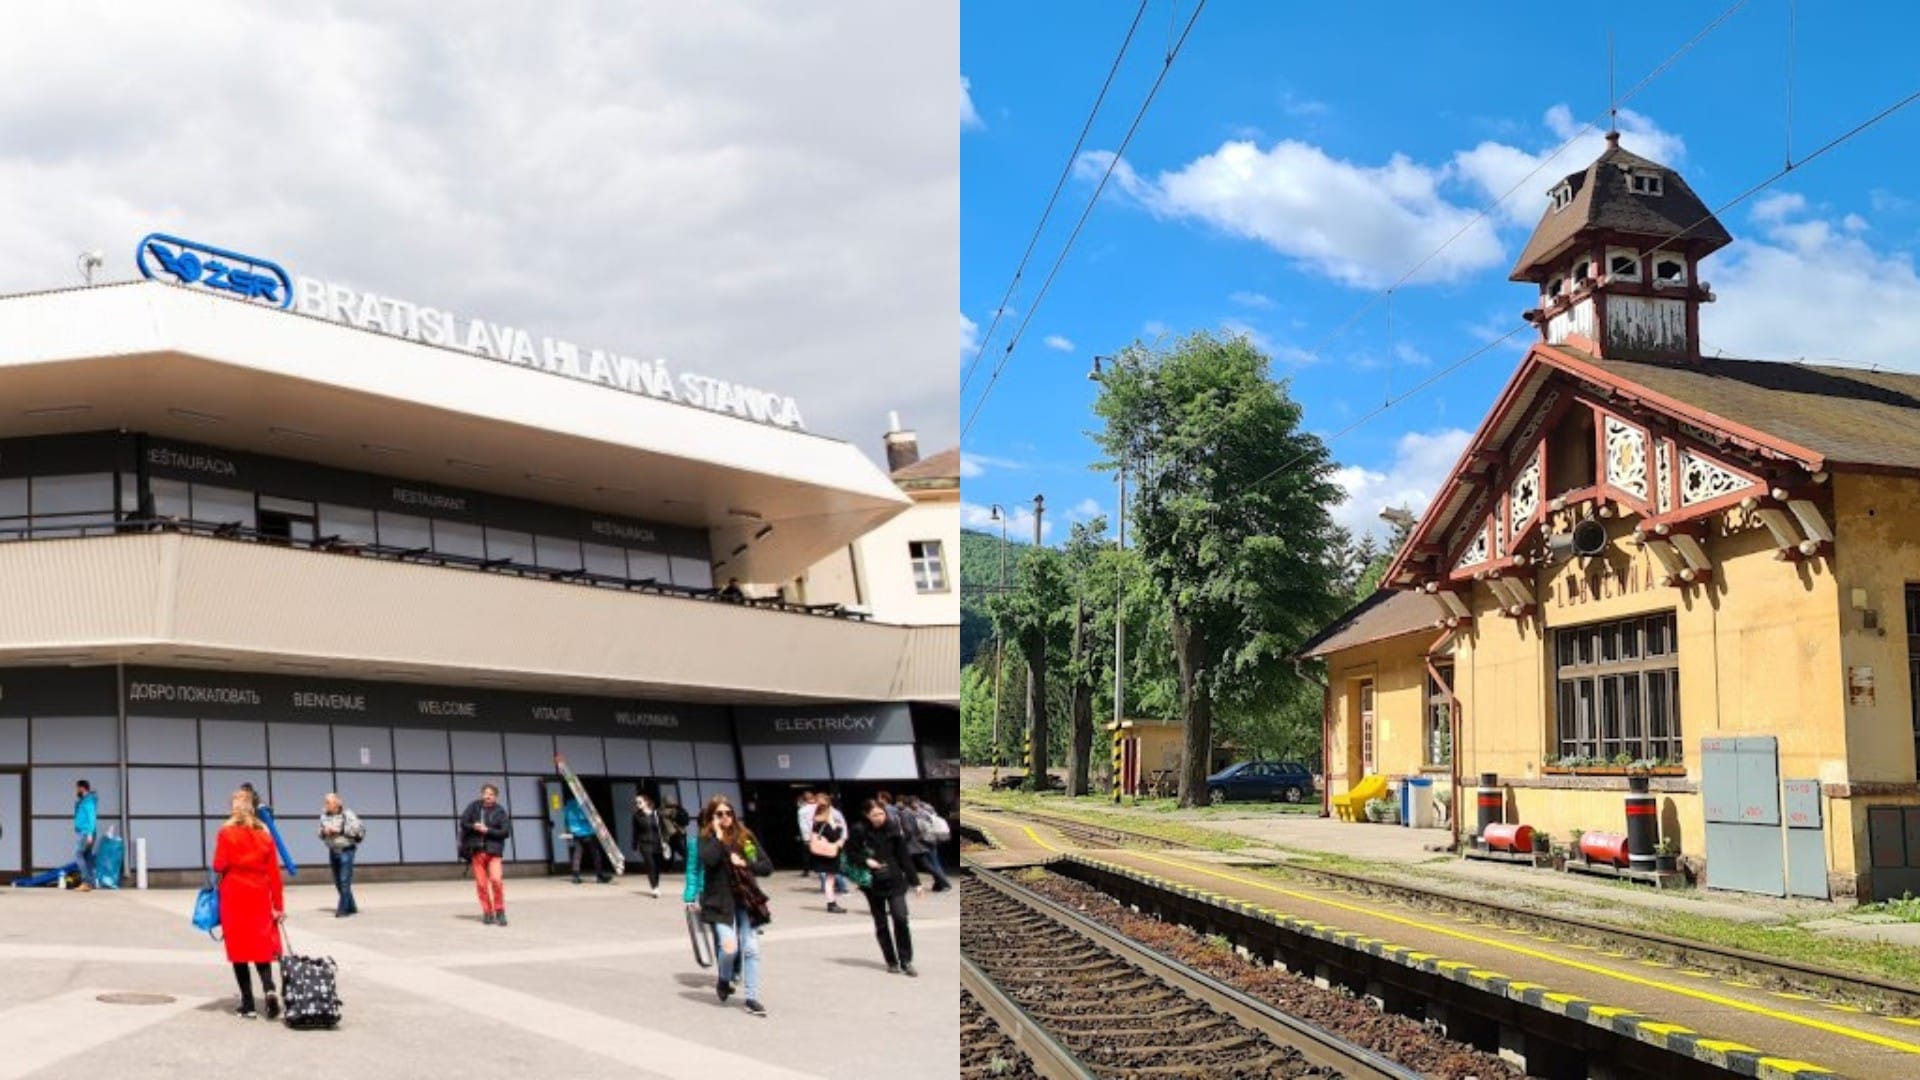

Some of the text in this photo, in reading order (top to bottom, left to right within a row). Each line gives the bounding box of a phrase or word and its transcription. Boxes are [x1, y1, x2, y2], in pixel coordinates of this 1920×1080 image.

[298, 276, 808, 433] BRATISLAVA HLAVNÁ STANICA
[129, 681, 261, 704] ДОБРО ПОЖАЛОВАТЬ
[293, 692, 366, 711] BIENVENUE
[417, 700, 477, 717] WELCOME
[774, 715, 876, 733] ELEKTRIČKY
